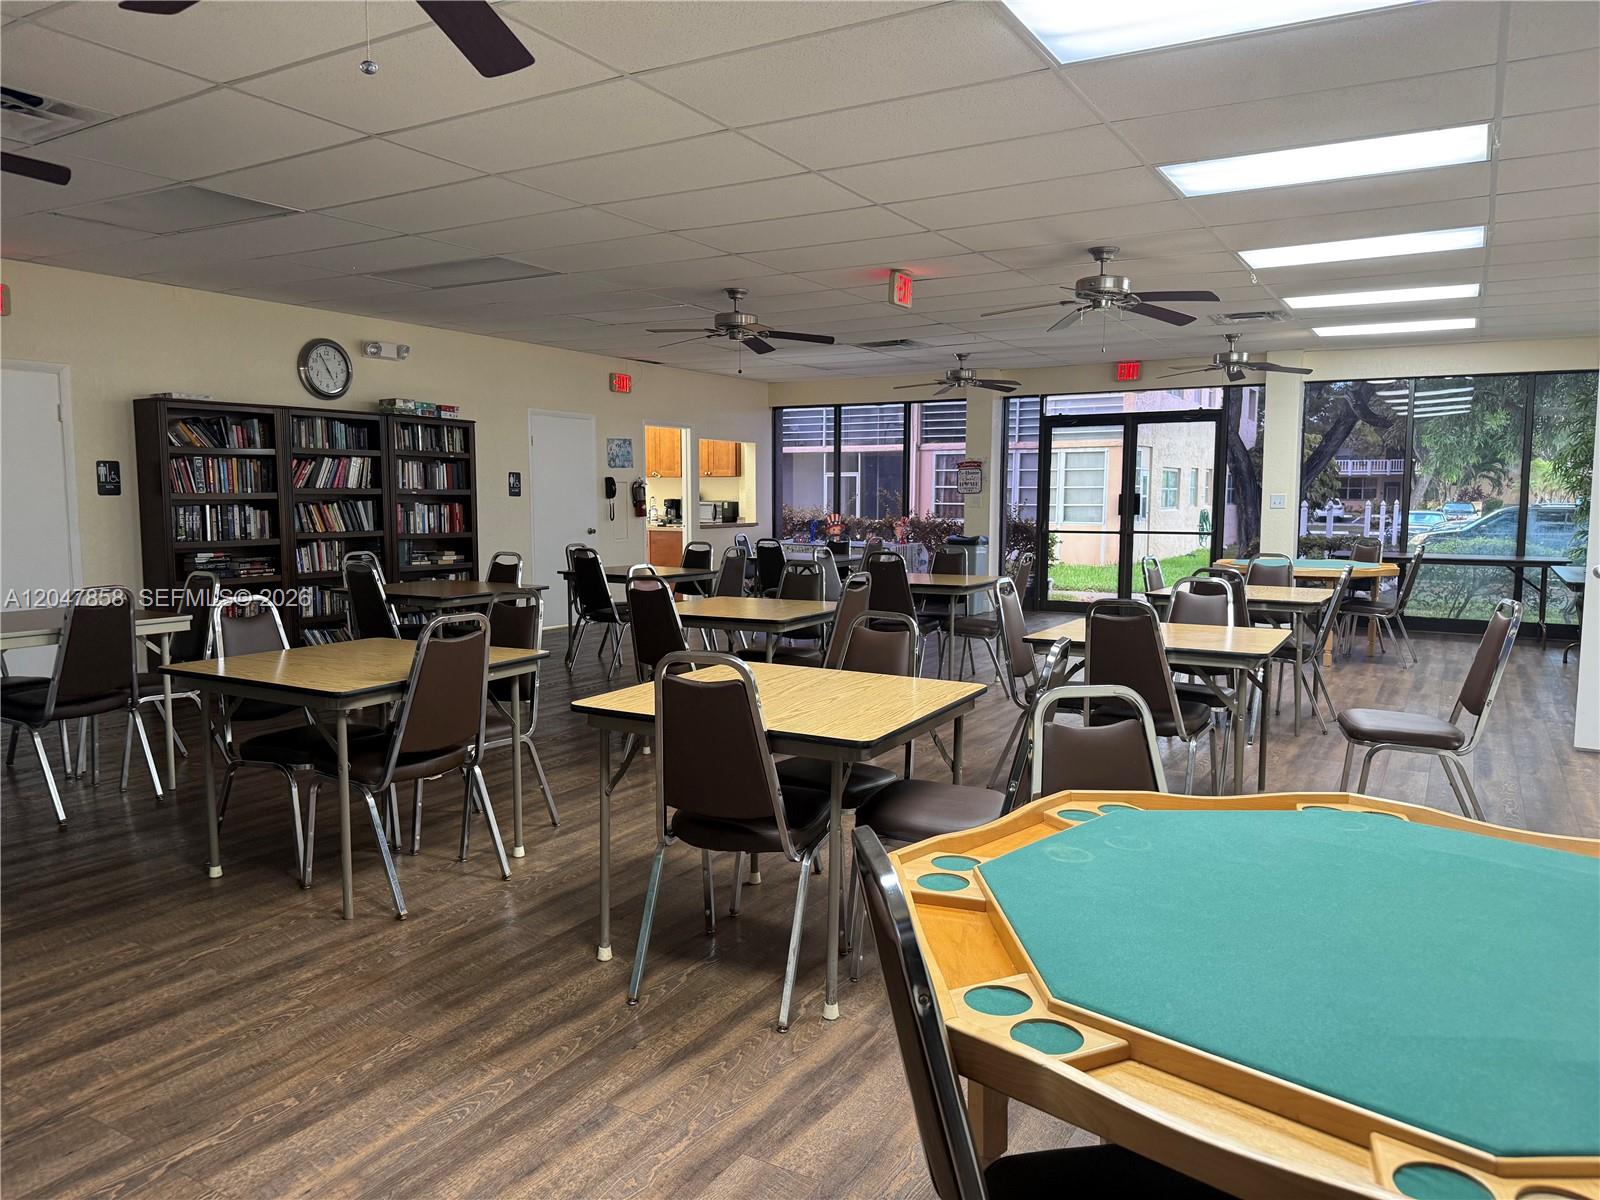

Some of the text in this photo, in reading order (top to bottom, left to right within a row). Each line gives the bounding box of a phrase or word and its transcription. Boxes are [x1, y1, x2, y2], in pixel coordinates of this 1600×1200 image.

[896, 273, 912, 305] EXIT
[1117, 362, 1139, 381] EXIT
[615, 373, 630, 392] EXIT
